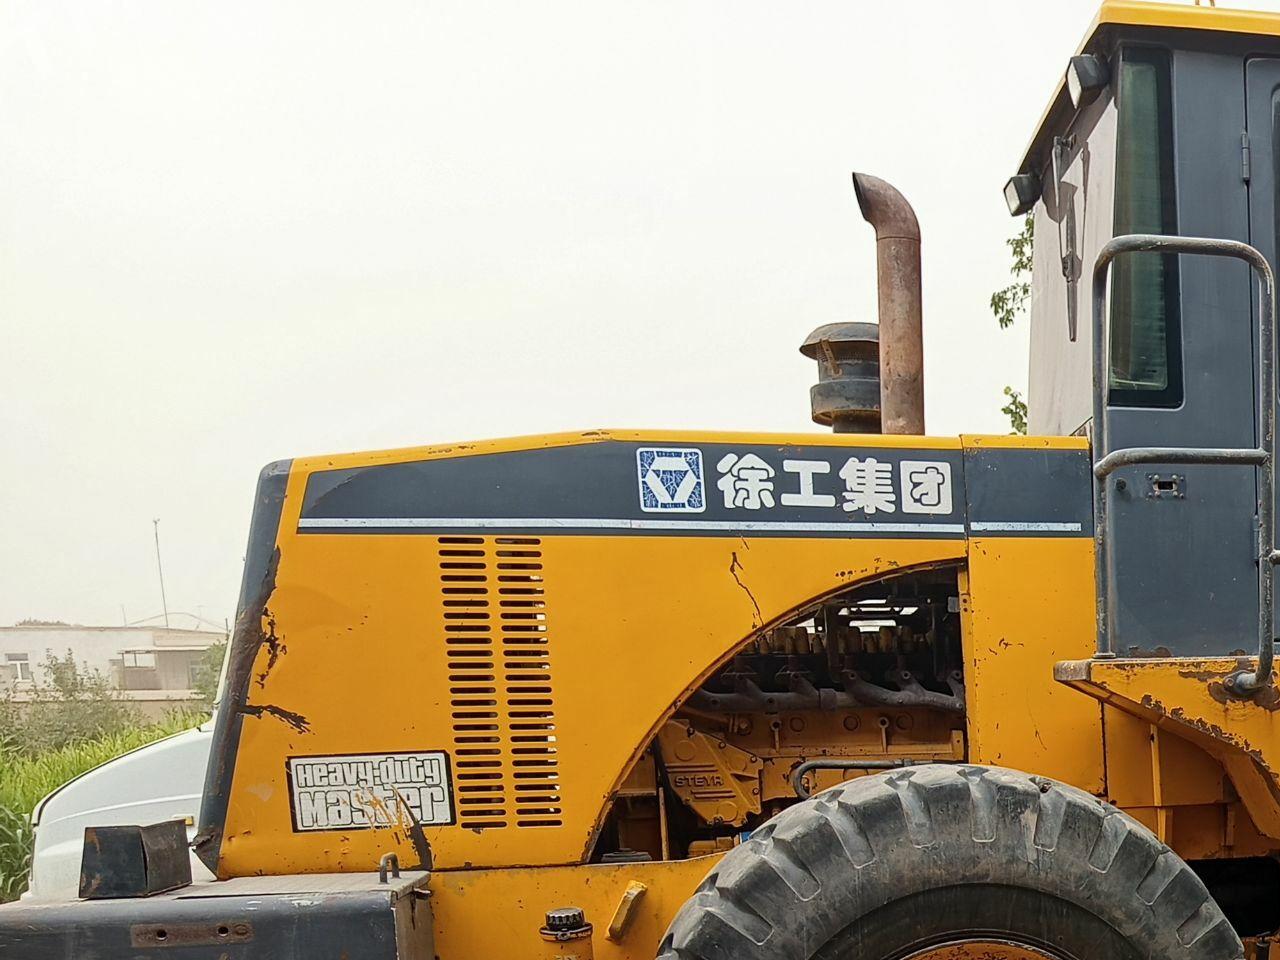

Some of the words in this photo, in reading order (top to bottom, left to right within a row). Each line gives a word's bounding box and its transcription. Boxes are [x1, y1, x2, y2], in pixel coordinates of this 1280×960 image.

[716, 452, 953, 514] 徐工集团
[675, 776, 724, 787] STEYR
